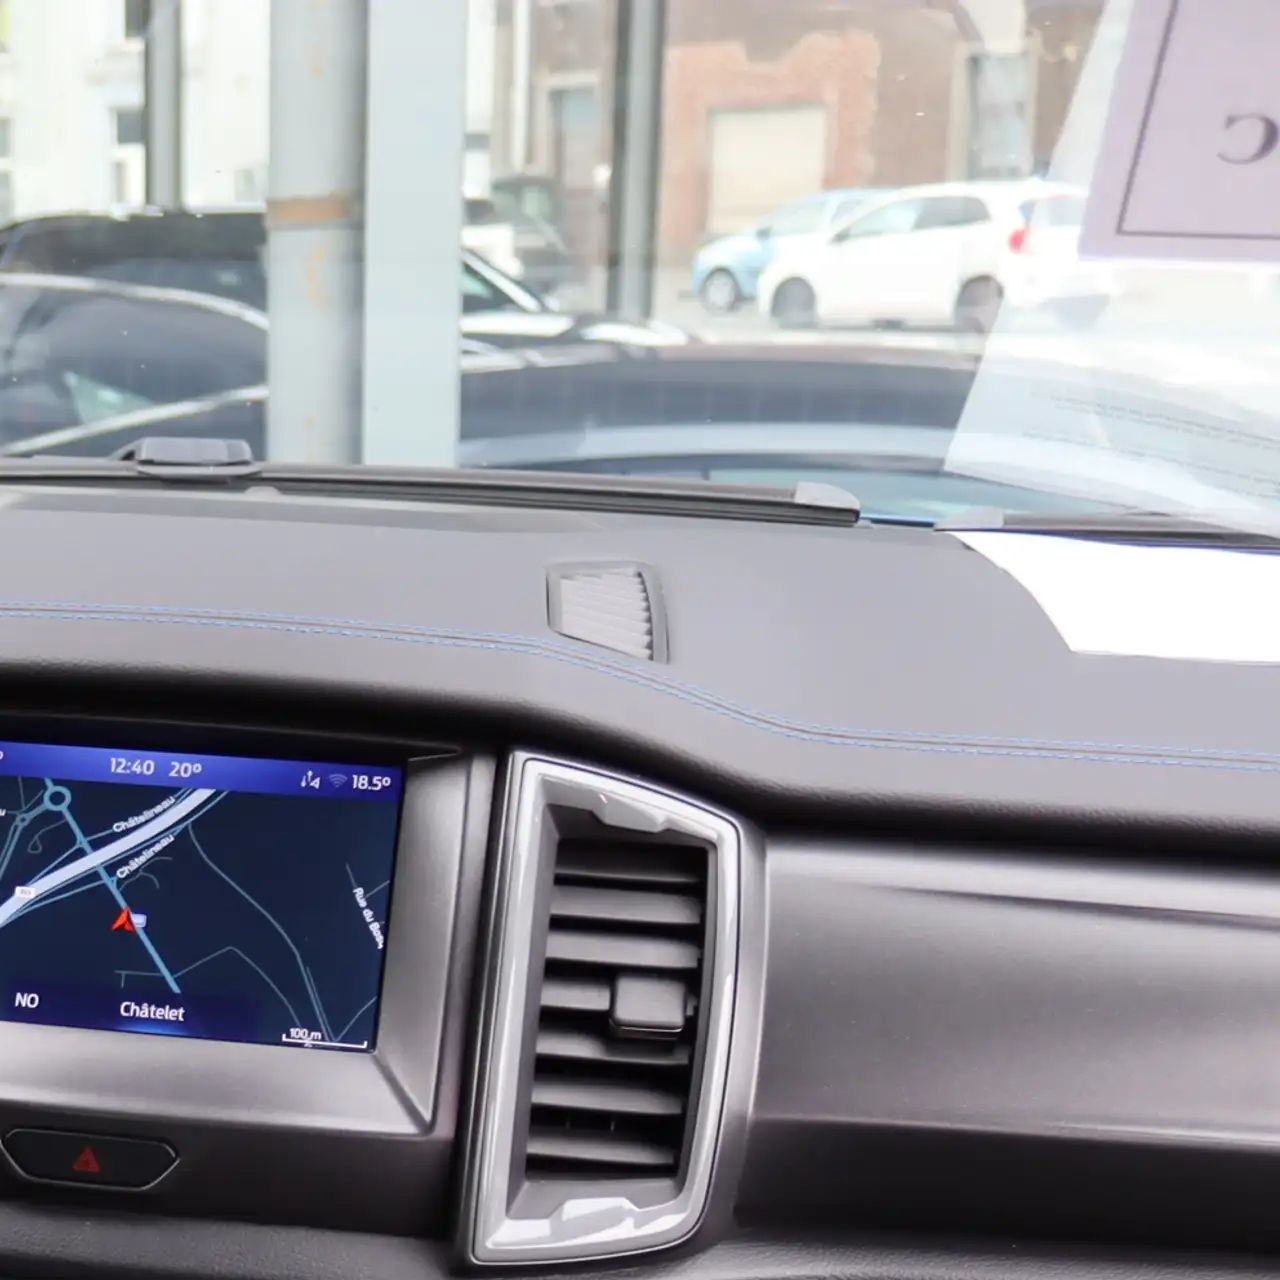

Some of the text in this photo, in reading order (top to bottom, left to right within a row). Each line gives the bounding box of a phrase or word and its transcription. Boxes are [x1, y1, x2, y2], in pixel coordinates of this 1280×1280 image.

[109, 757, 155, 776] 12:40
[112, 795, 176, 833] Châtelineau
[116, 833, 175, 880] Châtelineau
[352, 886, 368, 908] Rue
[362, 908, 374, 923] du
[14, 992, 40, 1009] NO
[119, 1000, 186, 1023] Châtelet
